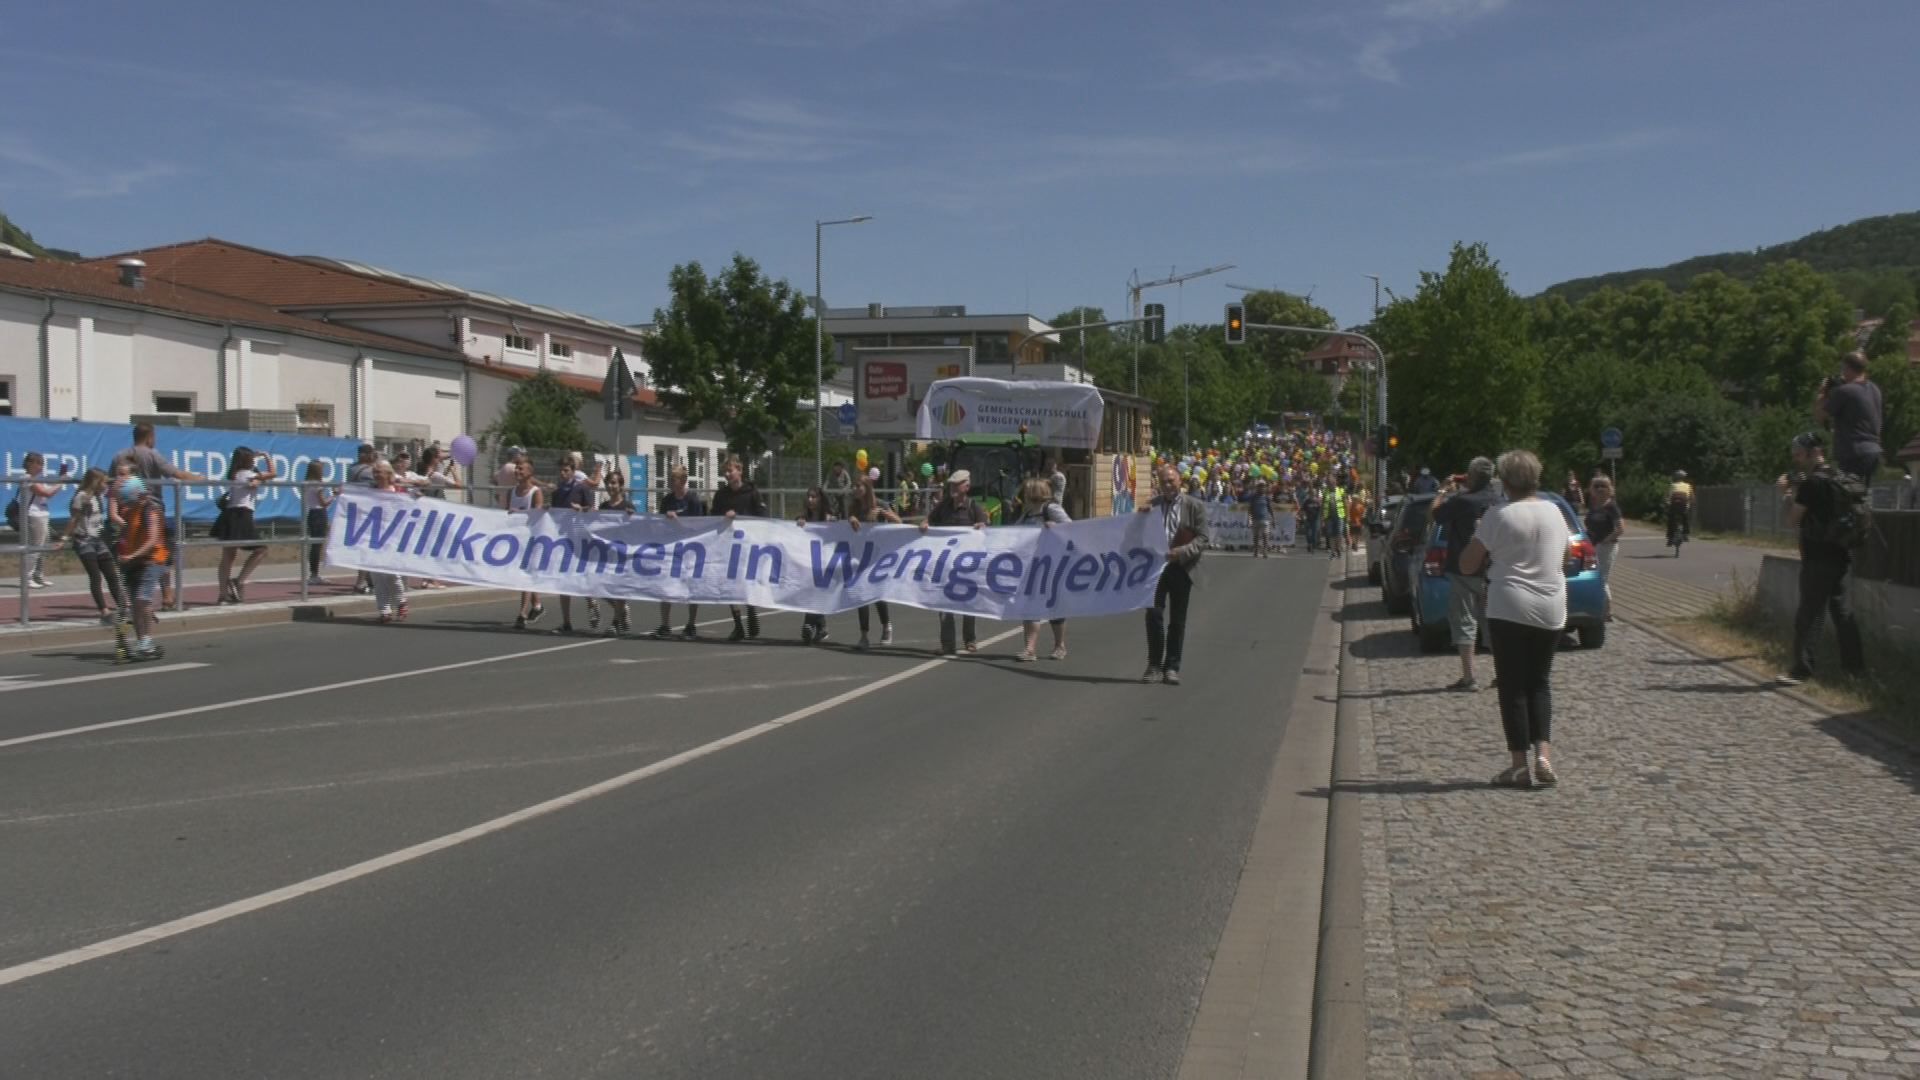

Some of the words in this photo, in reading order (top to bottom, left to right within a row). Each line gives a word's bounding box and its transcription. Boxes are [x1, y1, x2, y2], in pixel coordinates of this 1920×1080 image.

[977, 404, 1087, 419] GEMEINSCHAFTSSCHULE
[977, 415, 1042, 426] WENIGENJENA
[343, 502, 706, 579] Willkommen
[727, 530, 783, 584] in
[810, 538, 1156, 608] Wenigenjena
